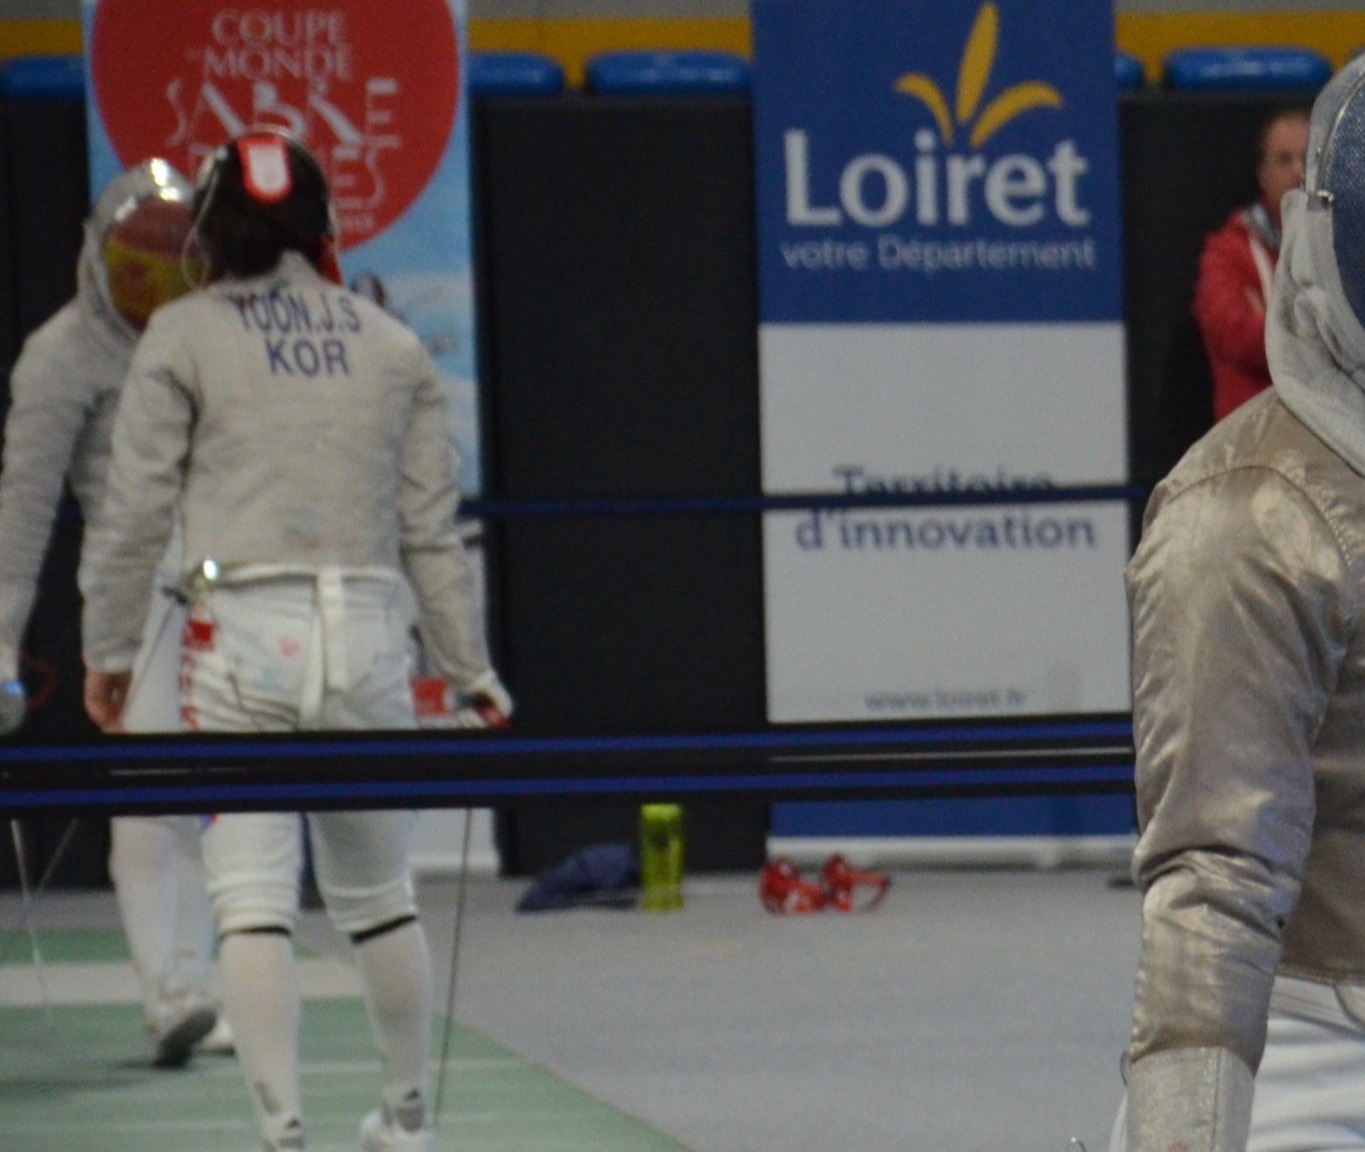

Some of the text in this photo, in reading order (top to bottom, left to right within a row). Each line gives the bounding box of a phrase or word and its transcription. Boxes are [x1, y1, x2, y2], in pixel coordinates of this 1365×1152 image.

[211, 9, 347, 46] COUPE
[202, 49, 352, 80] MONDE
[783, 129, 1091, 228] Loiret
[780, 234, 1096, 273] votre Département
[264, 336, 350, 379] KOR
[796, 506, 1096, 552] d'innovation
